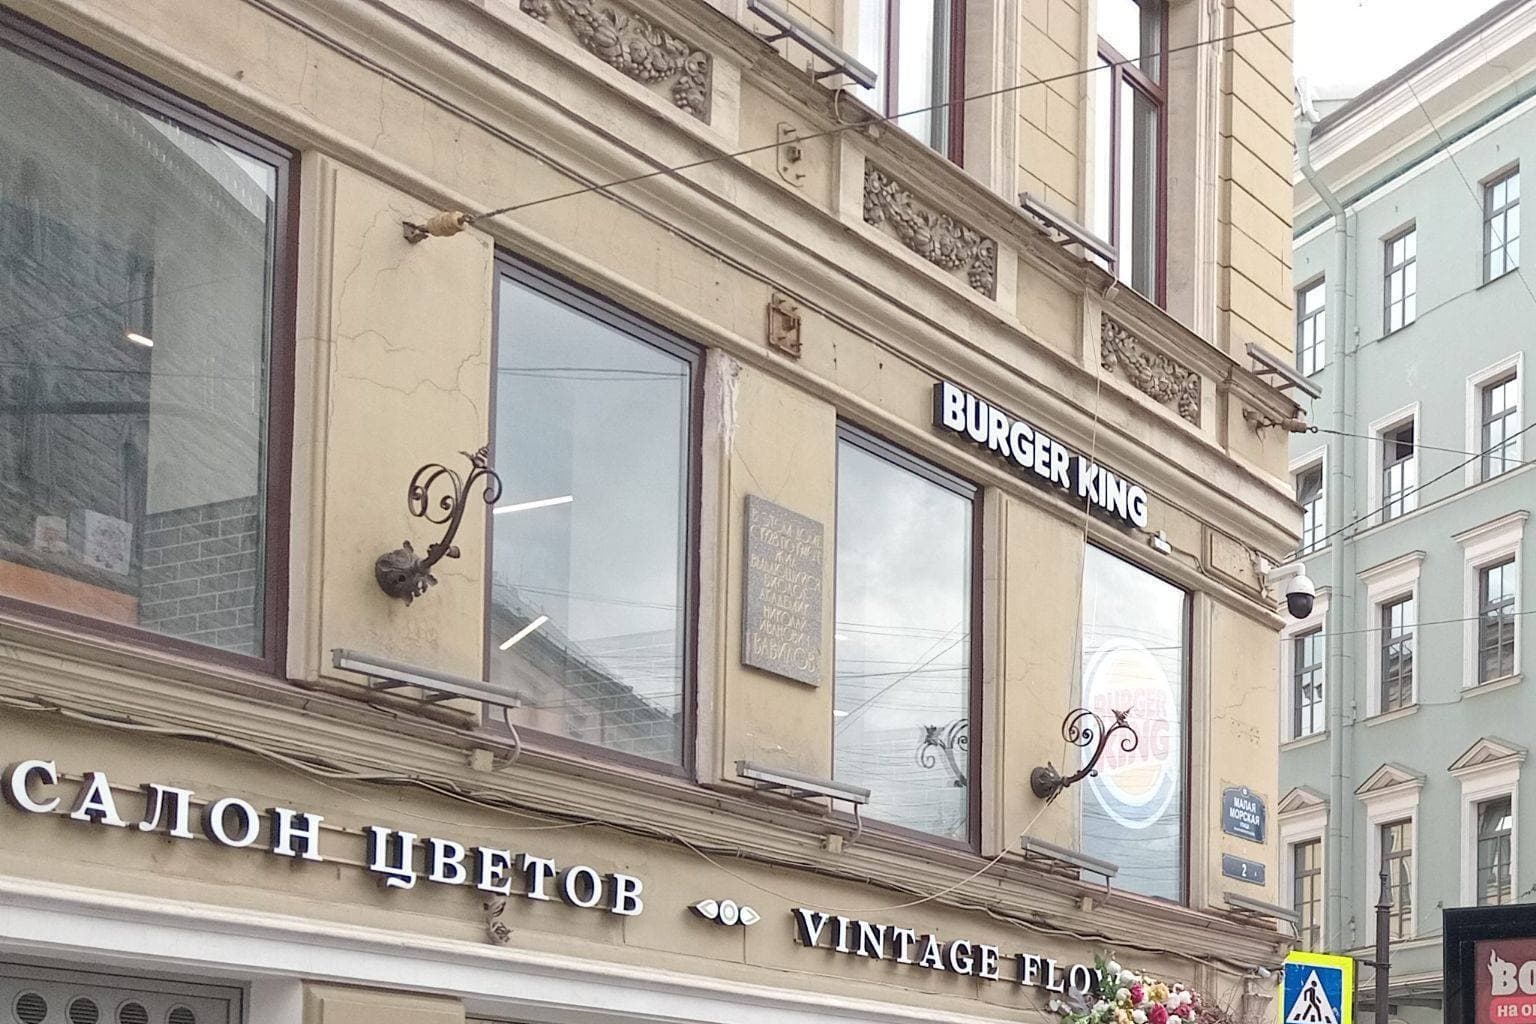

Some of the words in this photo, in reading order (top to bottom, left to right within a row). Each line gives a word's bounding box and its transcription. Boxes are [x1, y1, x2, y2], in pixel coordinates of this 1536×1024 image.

[940, 381, 1070, 489] BURGER
[1076, 455, 1148, 528] KING
[1233, 797, 1256, 813] МАЛАЯ
[1229, 807, 1260, 826] МОРСКАЯ
[8, 759, 325, 862] САЛОН
[366, 825, 645, 917] ЦВЕТОВ
[1241, 864, 1247, 877] 2
[794, 907, 1000, 981] VINTAGE
[1018, 953, 1104, 997] FLO
[1497, 1004, 1518, 1017] на
